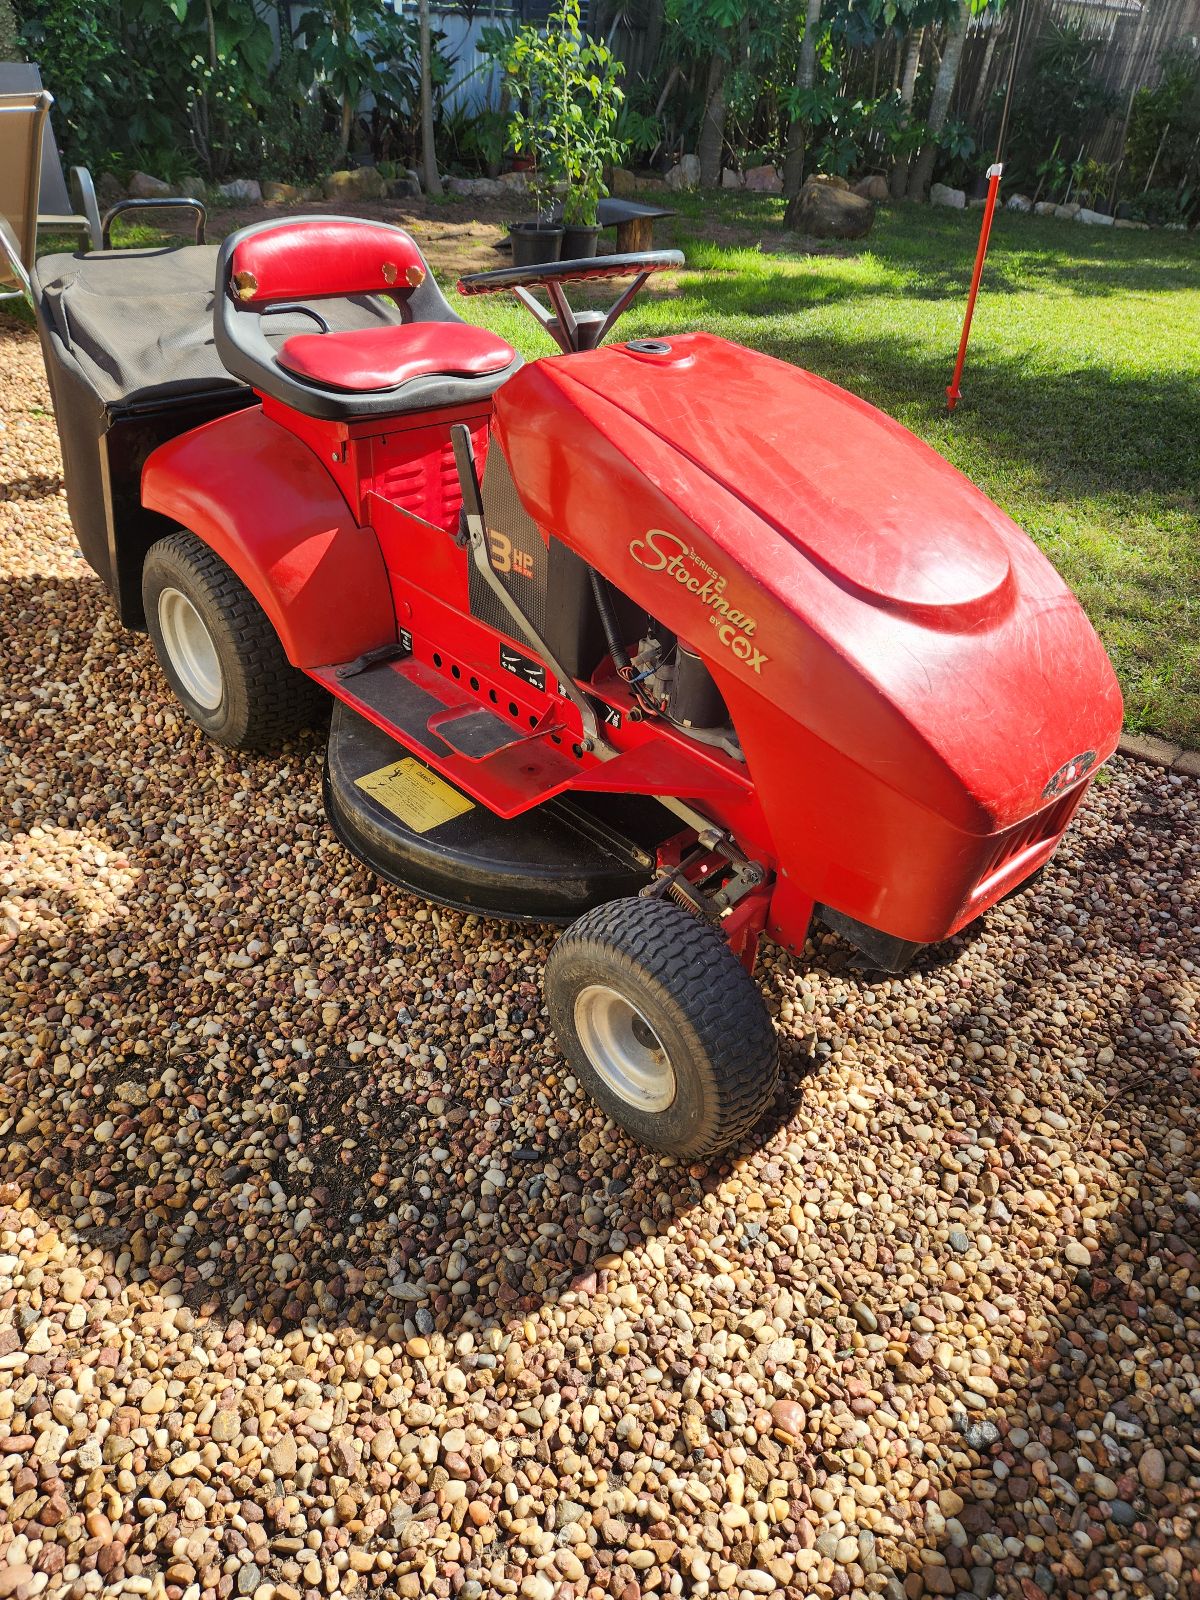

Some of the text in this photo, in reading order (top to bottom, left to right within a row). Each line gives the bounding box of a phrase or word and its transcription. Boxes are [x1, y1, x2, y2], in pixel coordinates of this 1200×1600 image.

[486, 527, 512, 573] 3
[690, 552, 727, 593] SERIES 2
[629, 529, 757, 636] Stockman
[709, 615, 768, 674] BY COX
[416, 771, 436, 786] DANGER
